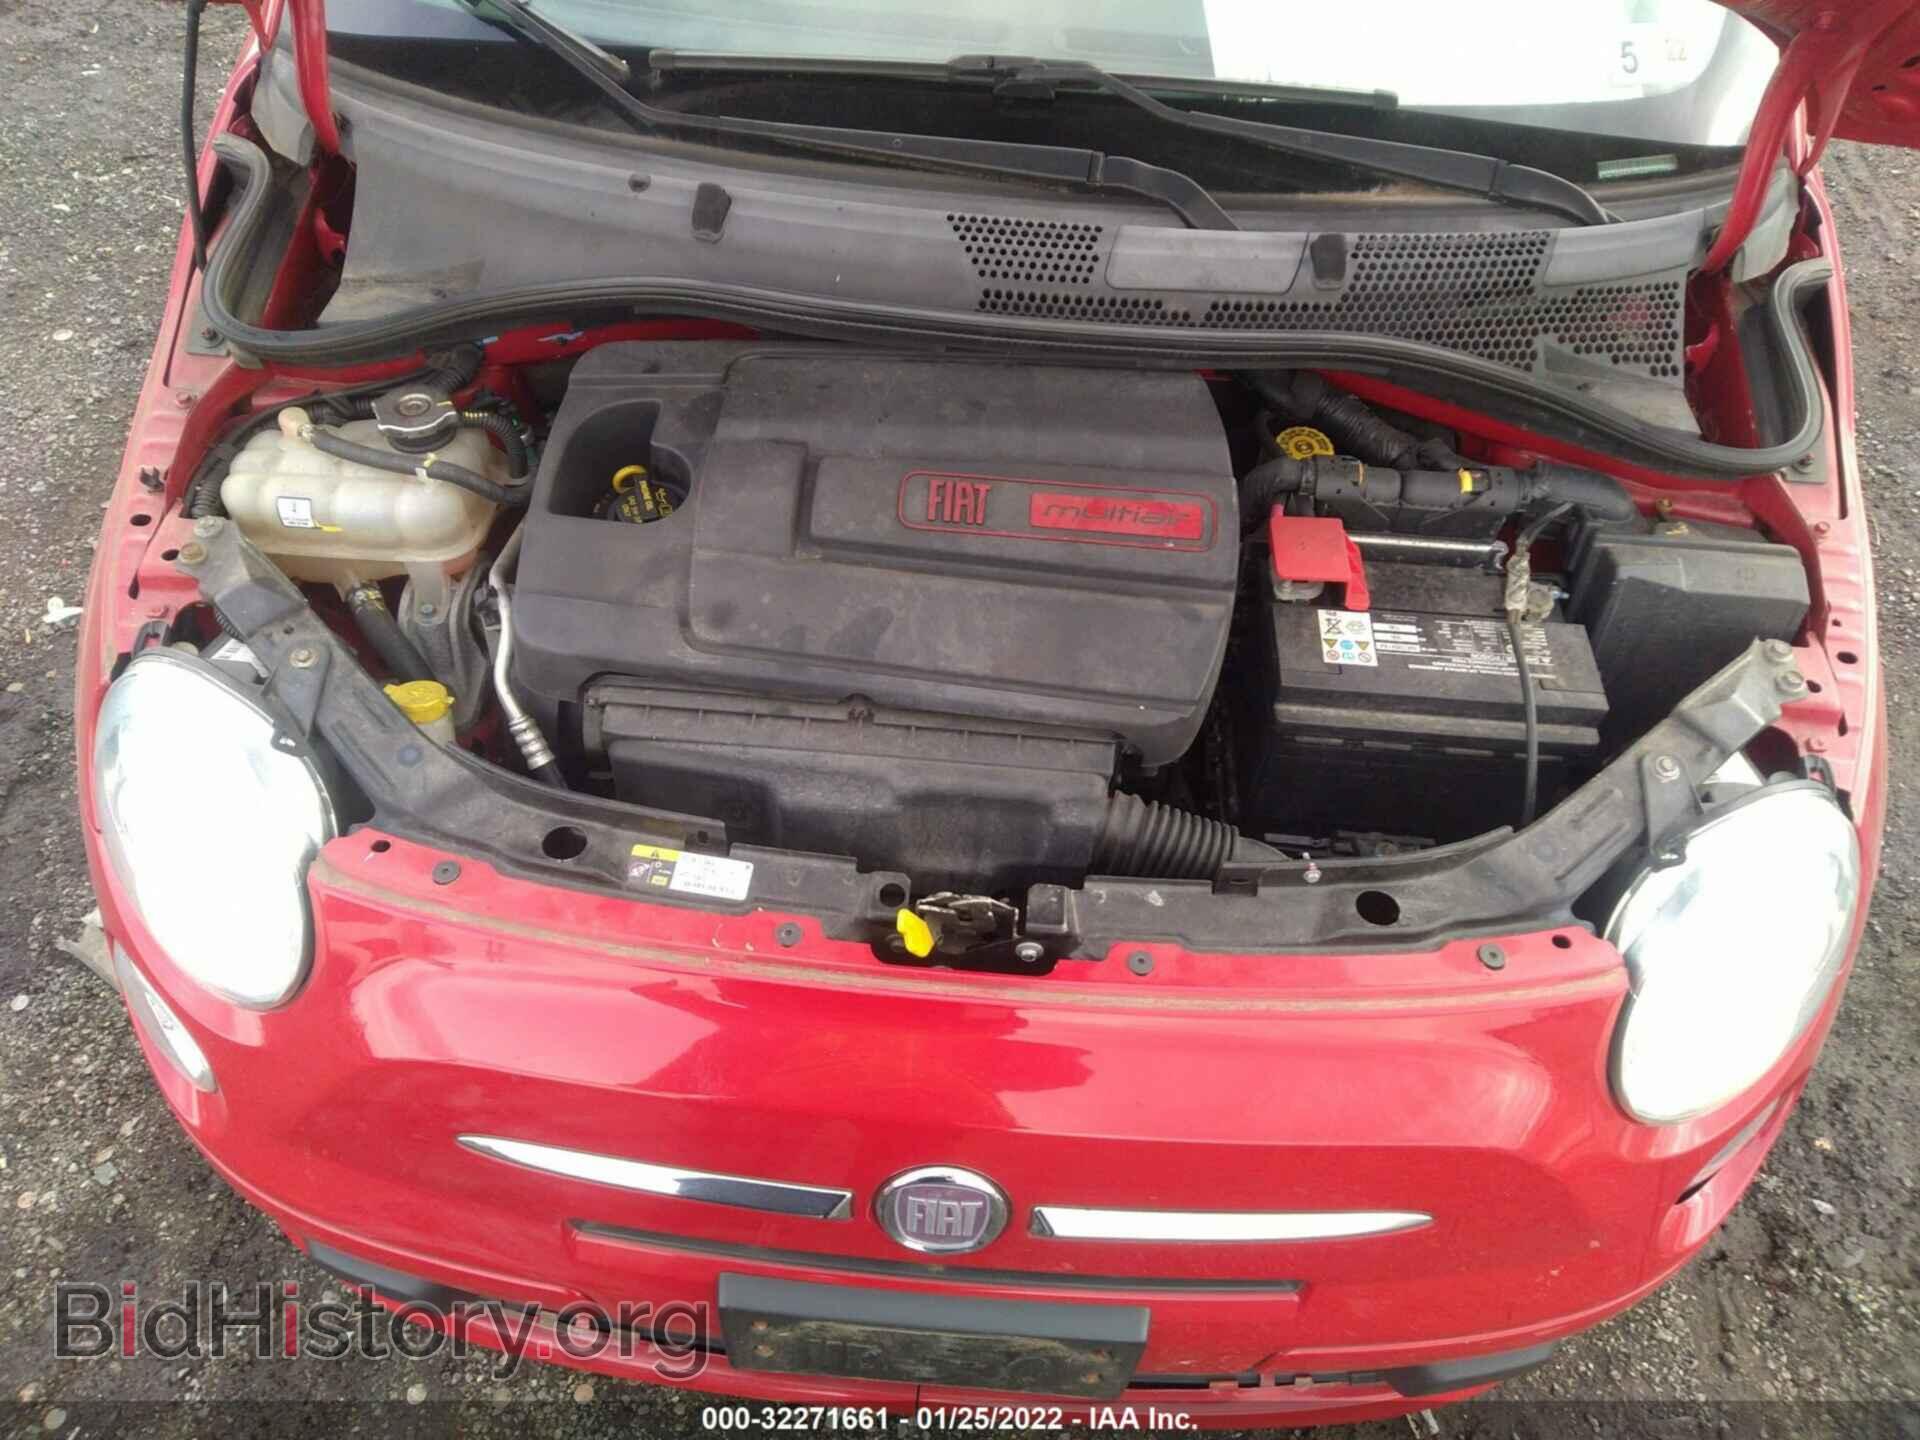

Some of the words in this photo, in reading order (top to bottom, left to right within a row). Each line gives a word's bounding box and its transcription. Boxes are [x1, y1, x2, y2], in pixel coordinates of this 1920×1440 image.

[1620, 40, 1639, 74] 5
[927, 479, 991, 525] FIAT
[906, 1196, 983, 1237] FIAT
